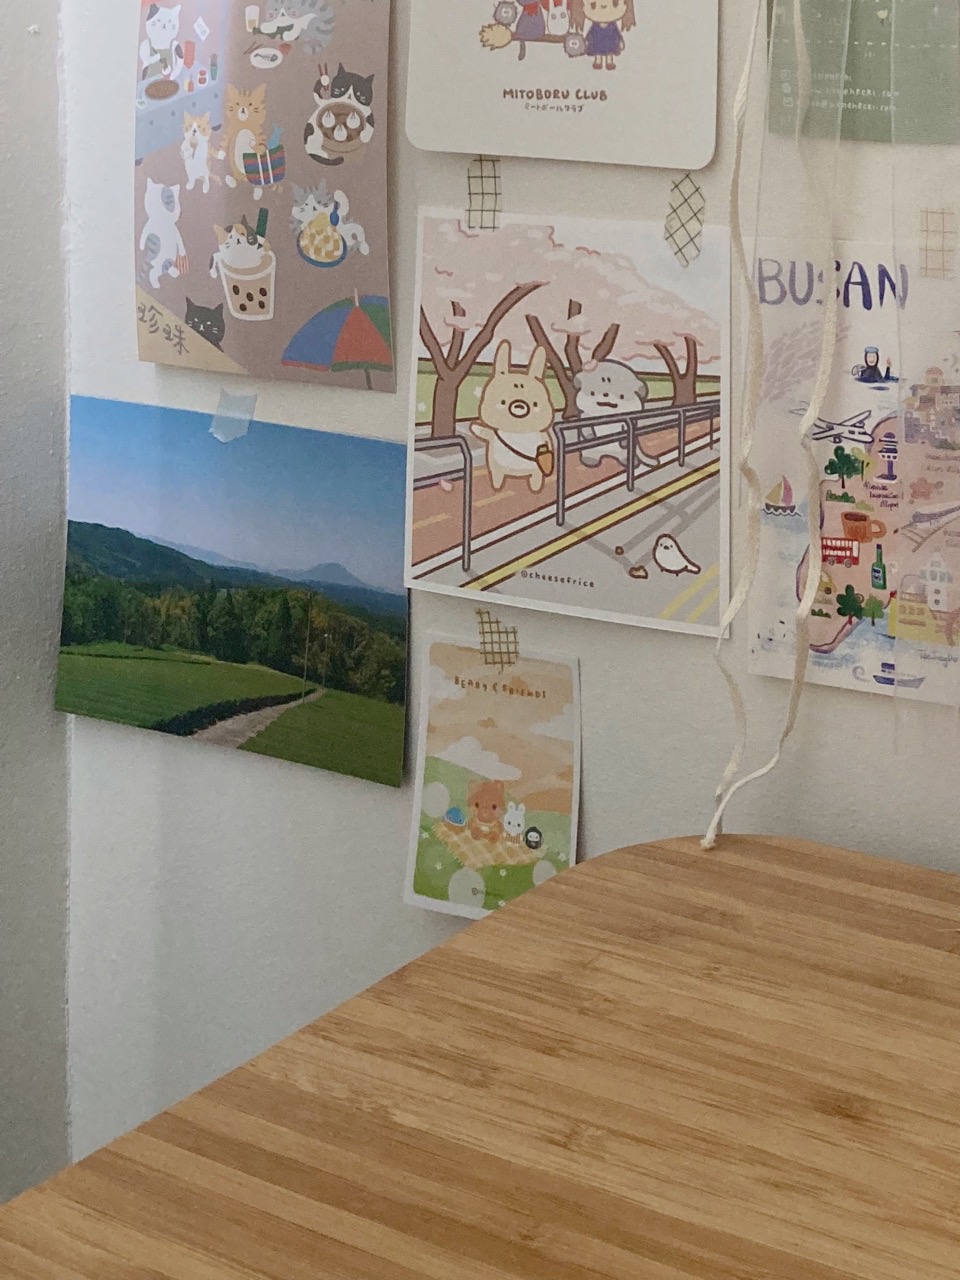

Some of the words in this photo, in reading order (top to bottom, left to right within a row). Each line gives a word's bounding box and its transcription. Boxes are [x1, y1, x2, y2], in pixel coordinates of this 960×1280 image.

[502, 88, 570, 101] MITOBORU
[574, 88, 608, 102] CLUB
[137, 301, 190, 356] 珍珠
